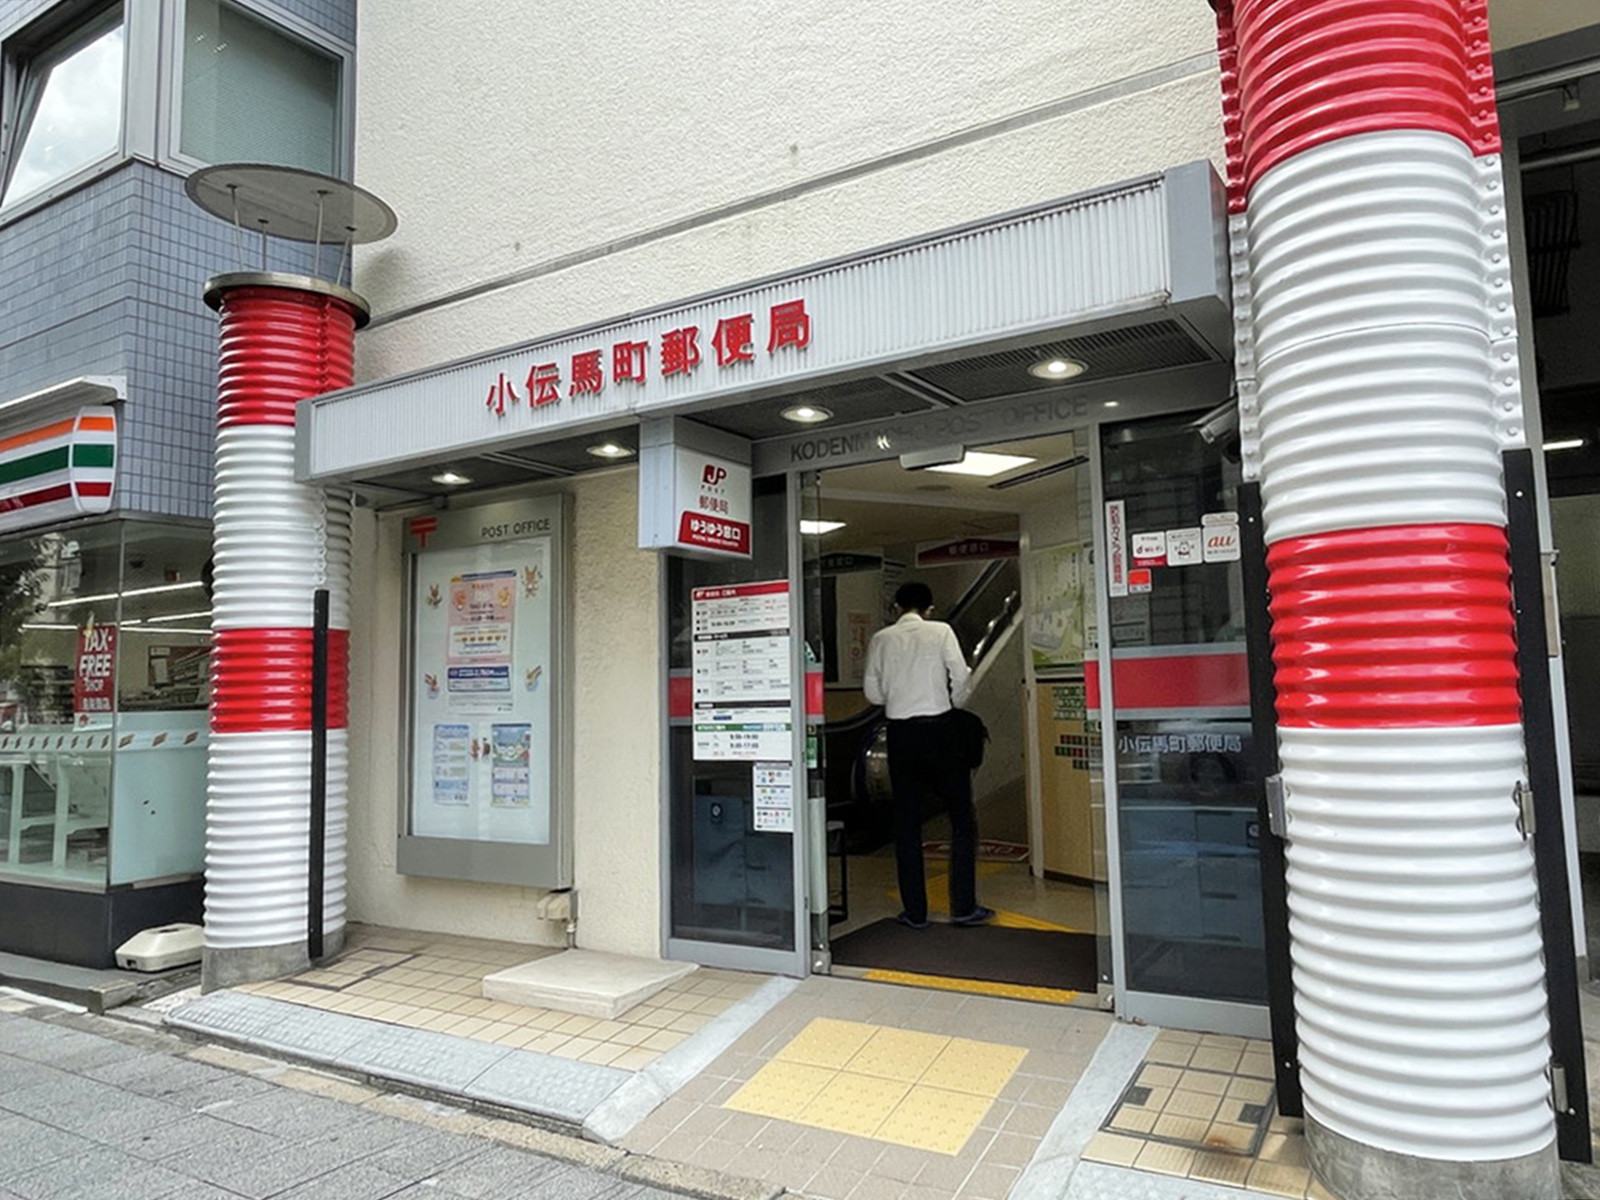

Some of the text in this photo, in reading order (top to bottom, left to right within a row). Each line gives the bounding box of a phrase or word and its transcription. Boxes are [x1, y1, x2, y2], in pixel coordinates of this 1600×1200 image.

[486, 299, 811, 416] 小伝馬町郵便局
[1002, 394, 1089, 427] OFFICE
[481, 518, 551, 538] POST OFFICE
[690, 518, 741, 540] ゆうゆう窓口
[1207, 535, 1237, 548] au
[79, 654, 111, 678] FREE
[1118, 734, 1242, 754] 小伝馬町郵便局
